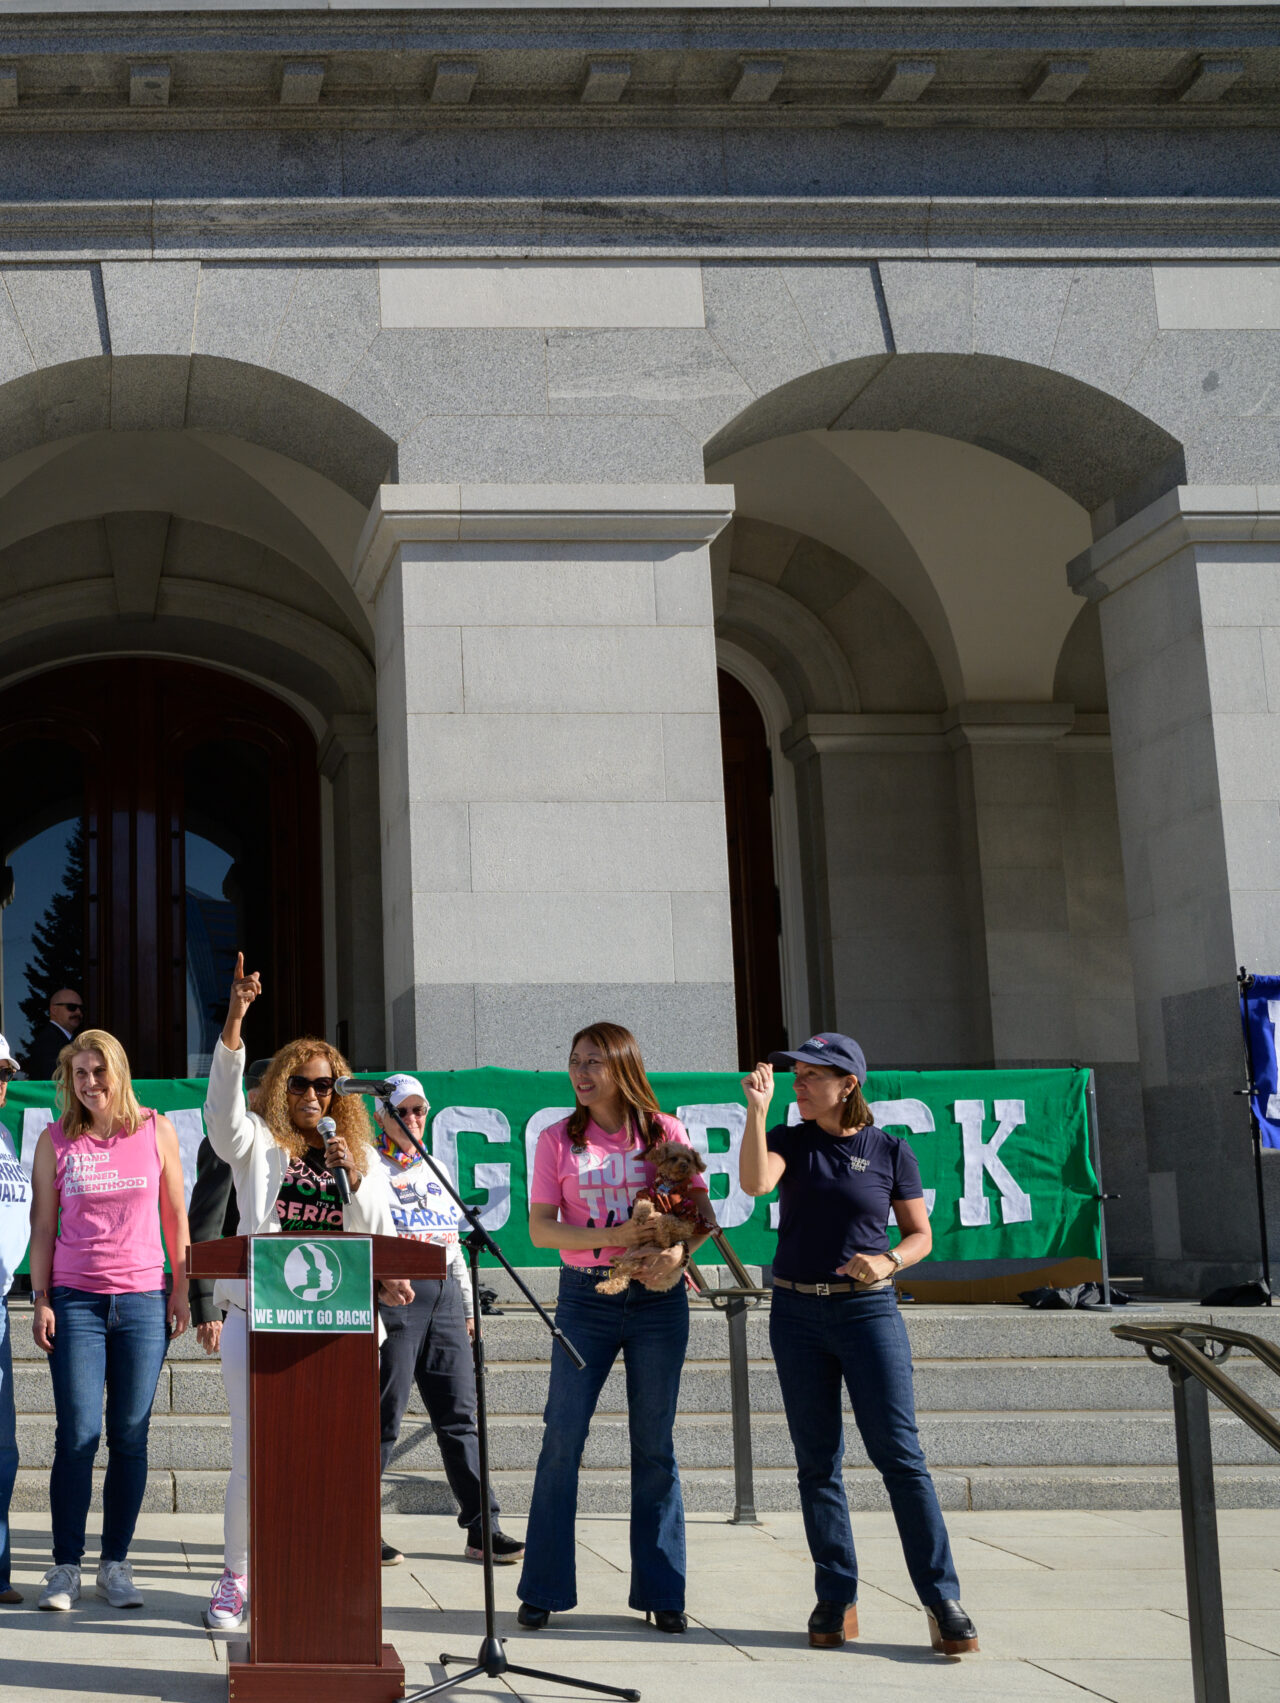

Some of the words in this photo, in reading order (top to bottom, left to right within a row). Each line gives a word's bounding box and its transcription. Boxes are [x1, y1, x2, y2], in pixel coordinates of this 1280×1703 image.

[578, 1149, 646, 1186] ROE
[66, 1178, 145, 1195] PARENTHOOD
[275, 1199, 343, 1226] SERIO
[255, 1309, 273, 1324] WE
[276, 1310, 314, 1325] WON'T
[317, 1310, 333, 1325] GO
[336, 1310, 371, 1325] BACK!
